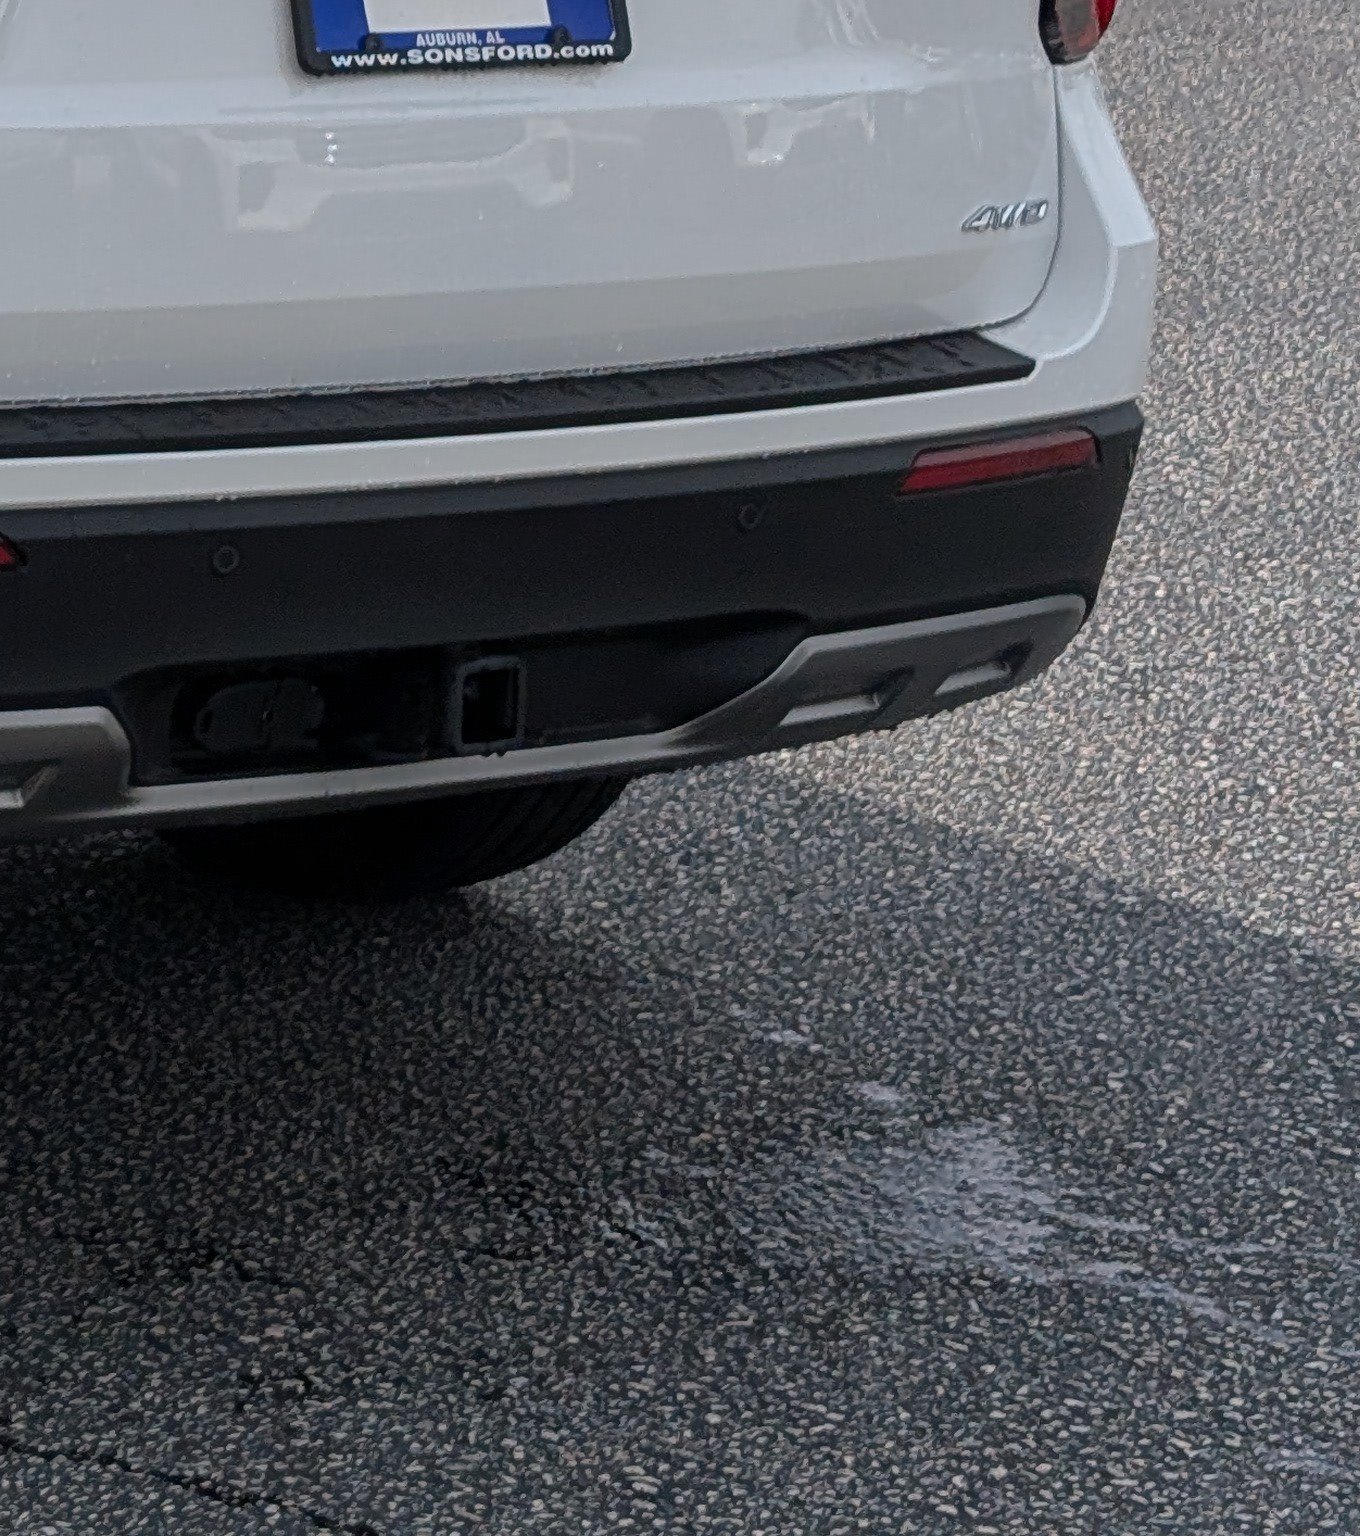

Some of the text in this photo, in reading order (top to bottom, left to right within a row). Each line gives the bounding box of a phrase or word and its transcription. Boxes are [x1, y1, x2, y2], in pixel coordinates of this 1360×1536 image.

[415, 30, 506, 48] AUBURN, AL
[330, 42, 615, 68] www.SONSFORD.com
